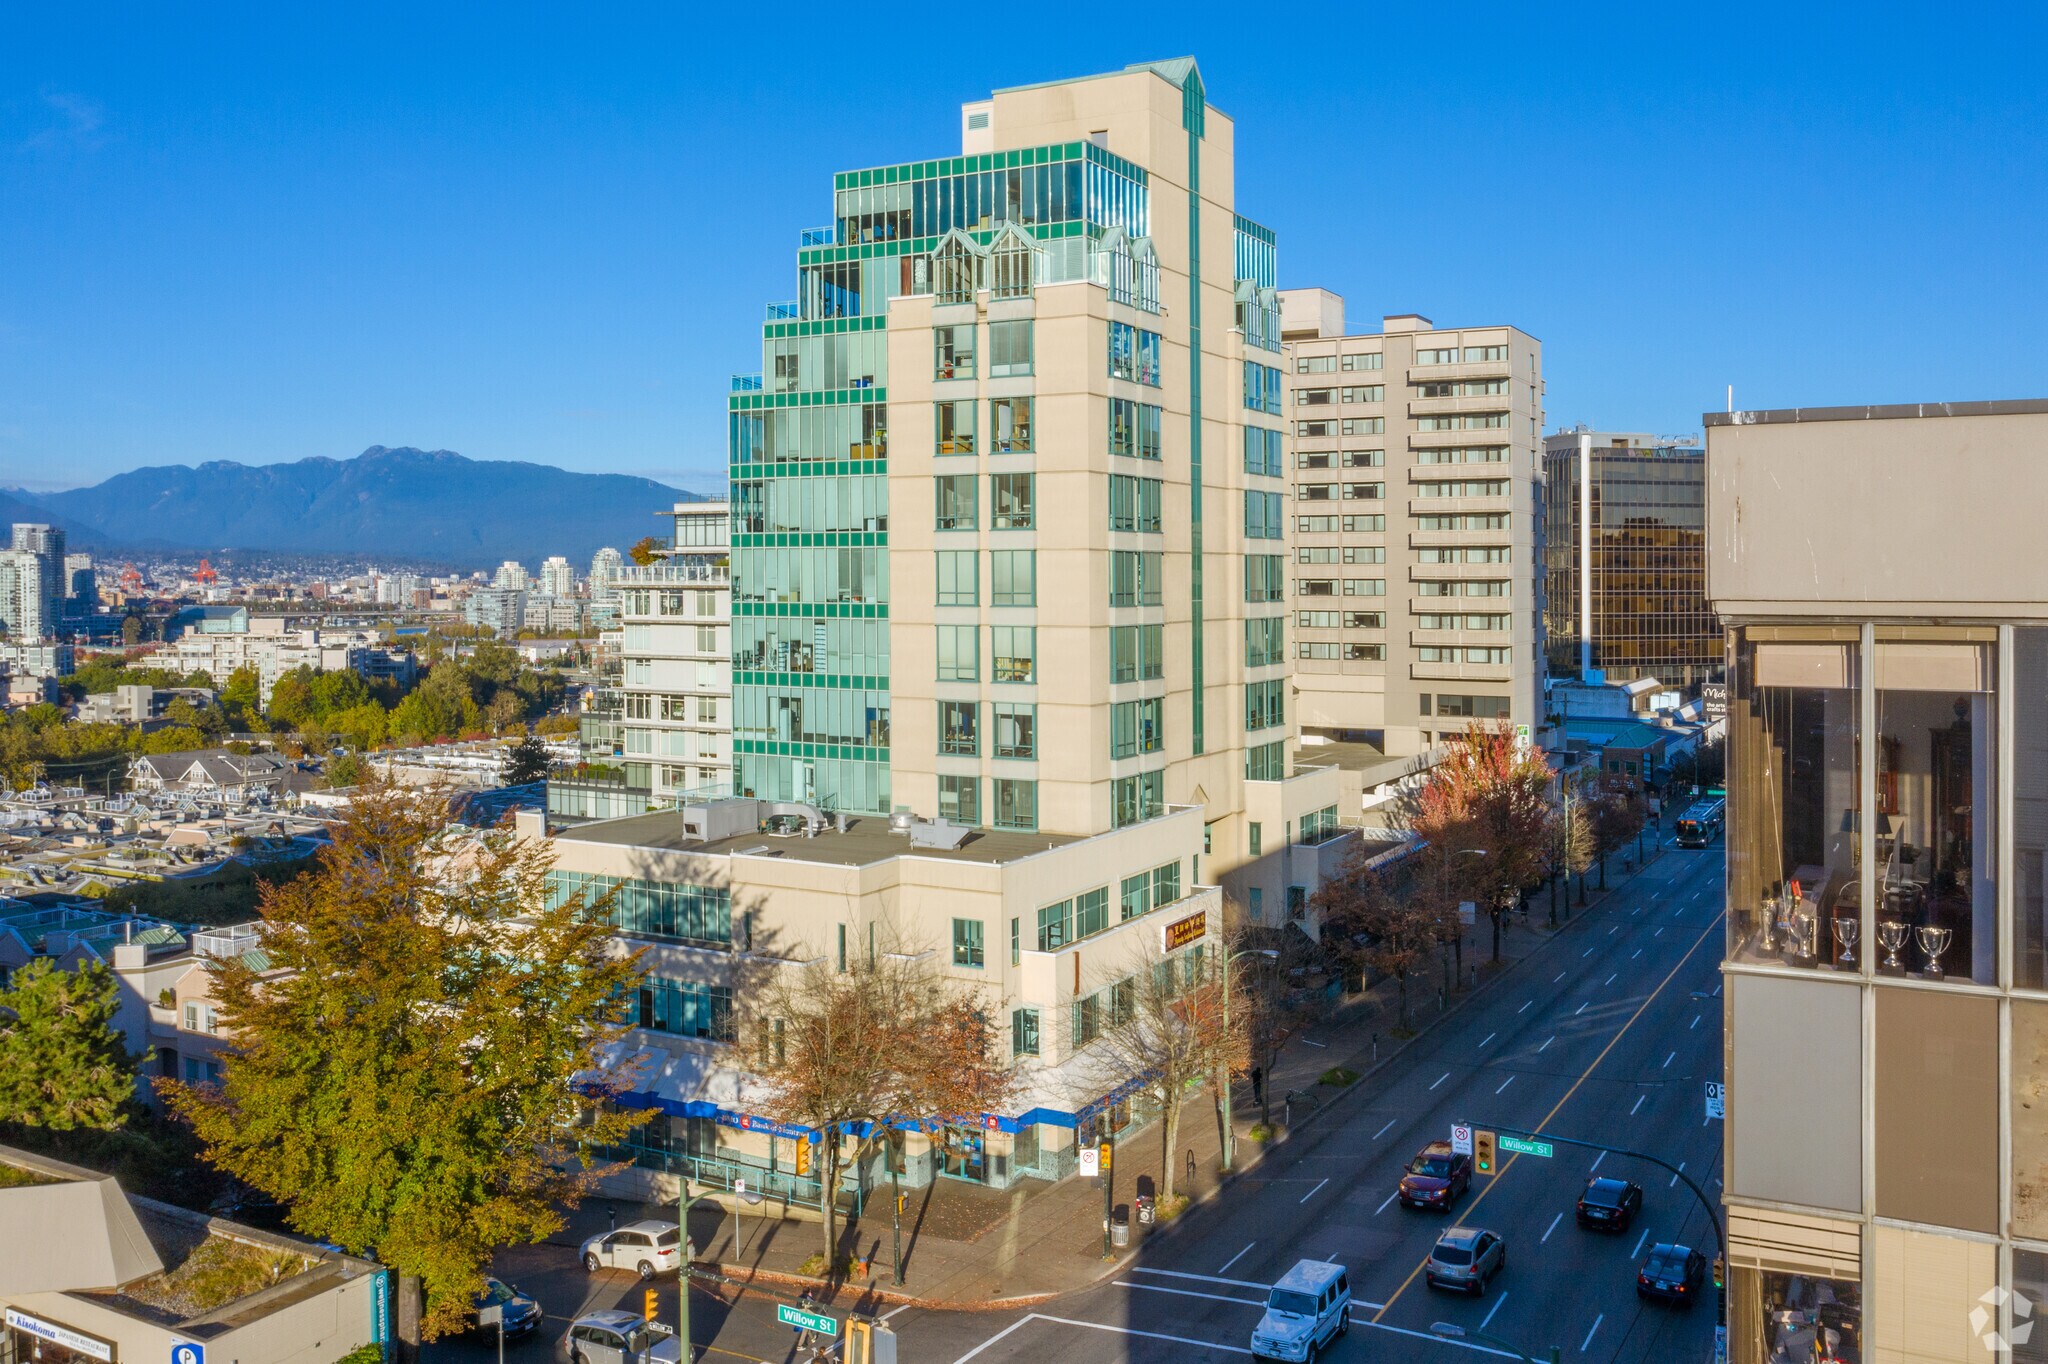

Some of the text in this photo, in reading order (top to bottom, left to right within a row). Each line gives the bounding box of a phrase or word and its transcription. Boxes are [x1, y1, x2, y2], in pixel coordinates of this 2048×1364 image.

[752, 1119, 769, 1130] Bank
[1505, 1140, 1547, 1154] Willow St
[16, 1315, 56, 1339] Kisokoma
[783, 1309, 831, 1331] Willow St
